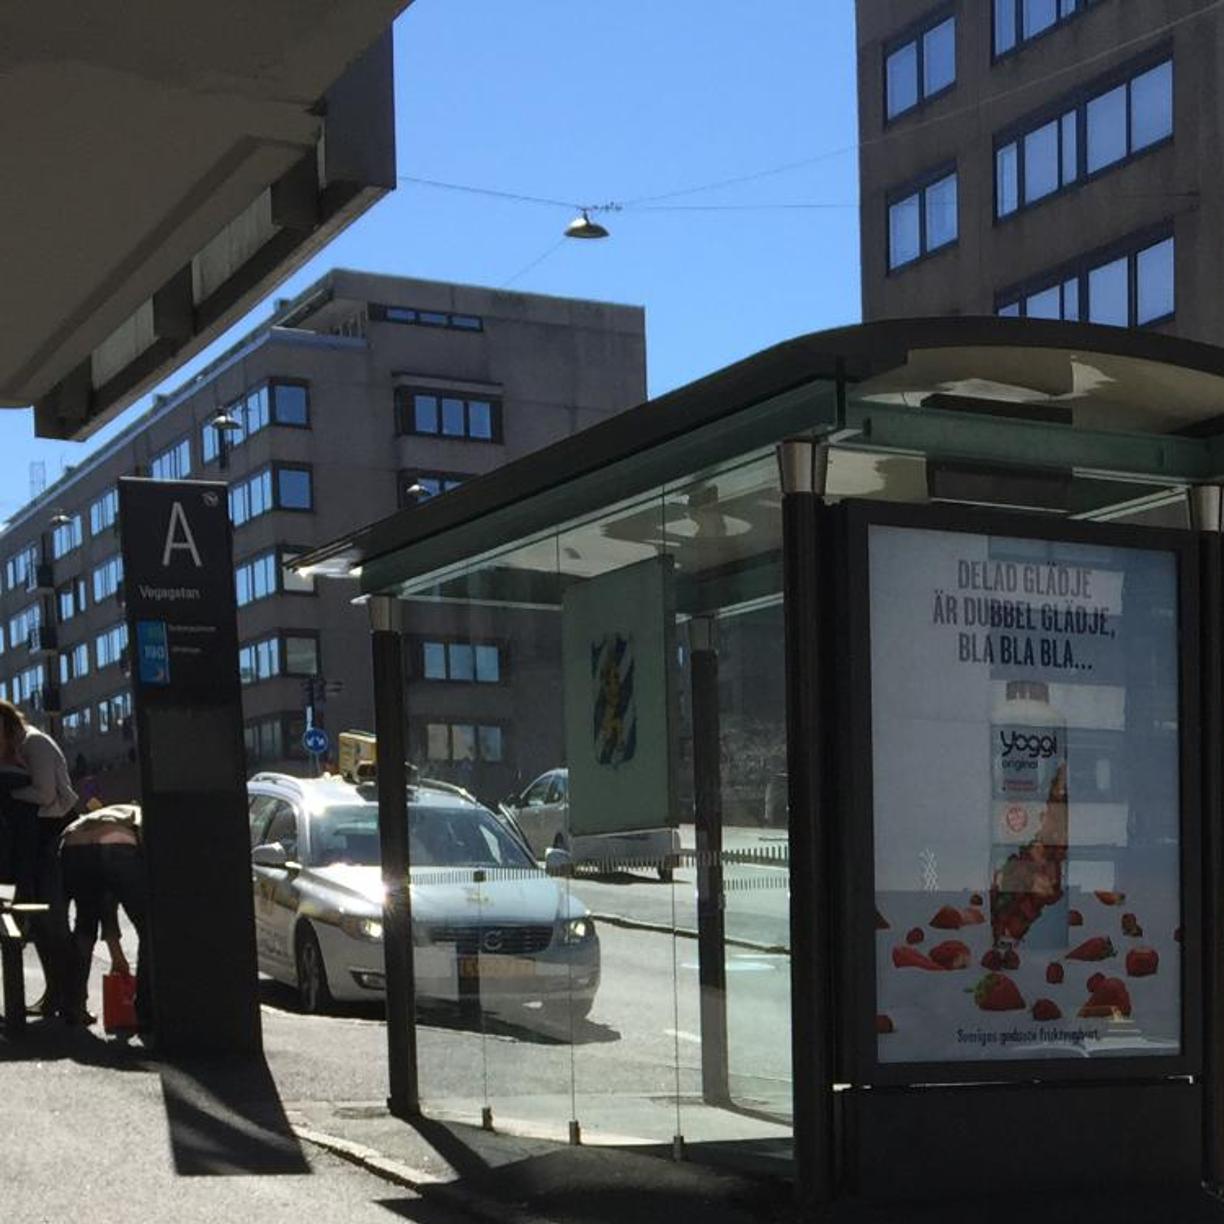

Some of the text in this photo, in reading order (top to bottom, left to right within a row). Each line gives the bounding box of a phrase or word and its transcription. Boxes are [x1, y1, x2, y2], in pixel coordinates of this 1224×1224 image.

[162, 500, 202, 567] A
[957, 559, 1093, 599] DELAD GLÄDJE
[933, 590, 1116, 638] ÄR DUBBEL GLÄDJE,
[958, 632, 1093, 670] BLA BLA BLA...
[1000, 730, 1057, 758] yoggi
[1001, 758, 1038, 771] original
